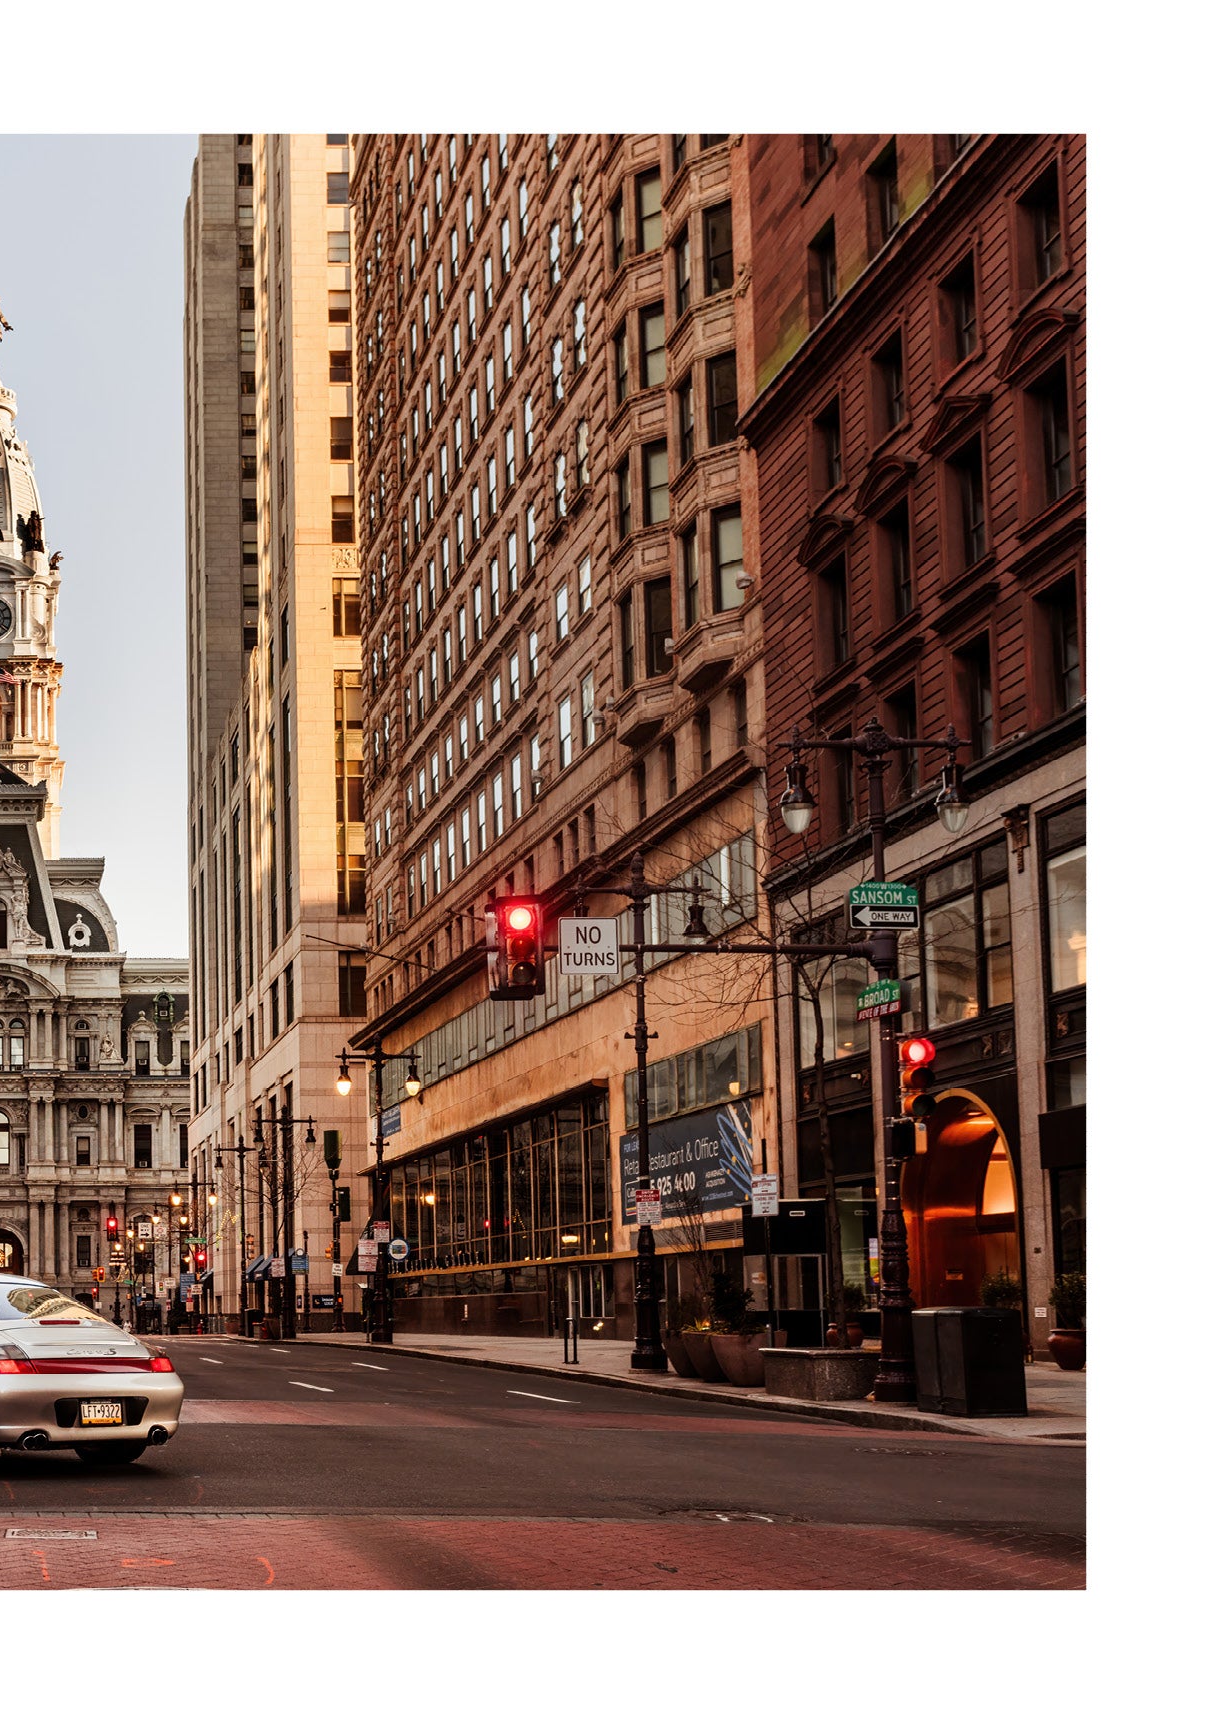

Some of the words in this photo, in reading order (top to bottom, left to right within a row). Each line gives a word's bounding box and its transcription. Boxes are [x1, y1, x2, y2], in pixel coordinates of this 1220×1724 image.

[852, 890, 903, 904] SANSOM
[906, 895, 917, 904] ST
[871, 912, 889, 921] ONE
[893, 912, 911, 921] WAY
[576, 926, 601, 944] NO
[563, 952, 615, 966] TURNS
[864, 988, 890, 1007] BROAD
[648, 1147, 684, 1171] estaurant
[686, 1142, 693, 1162] &
[694, 1136, 719, 1161] Office
